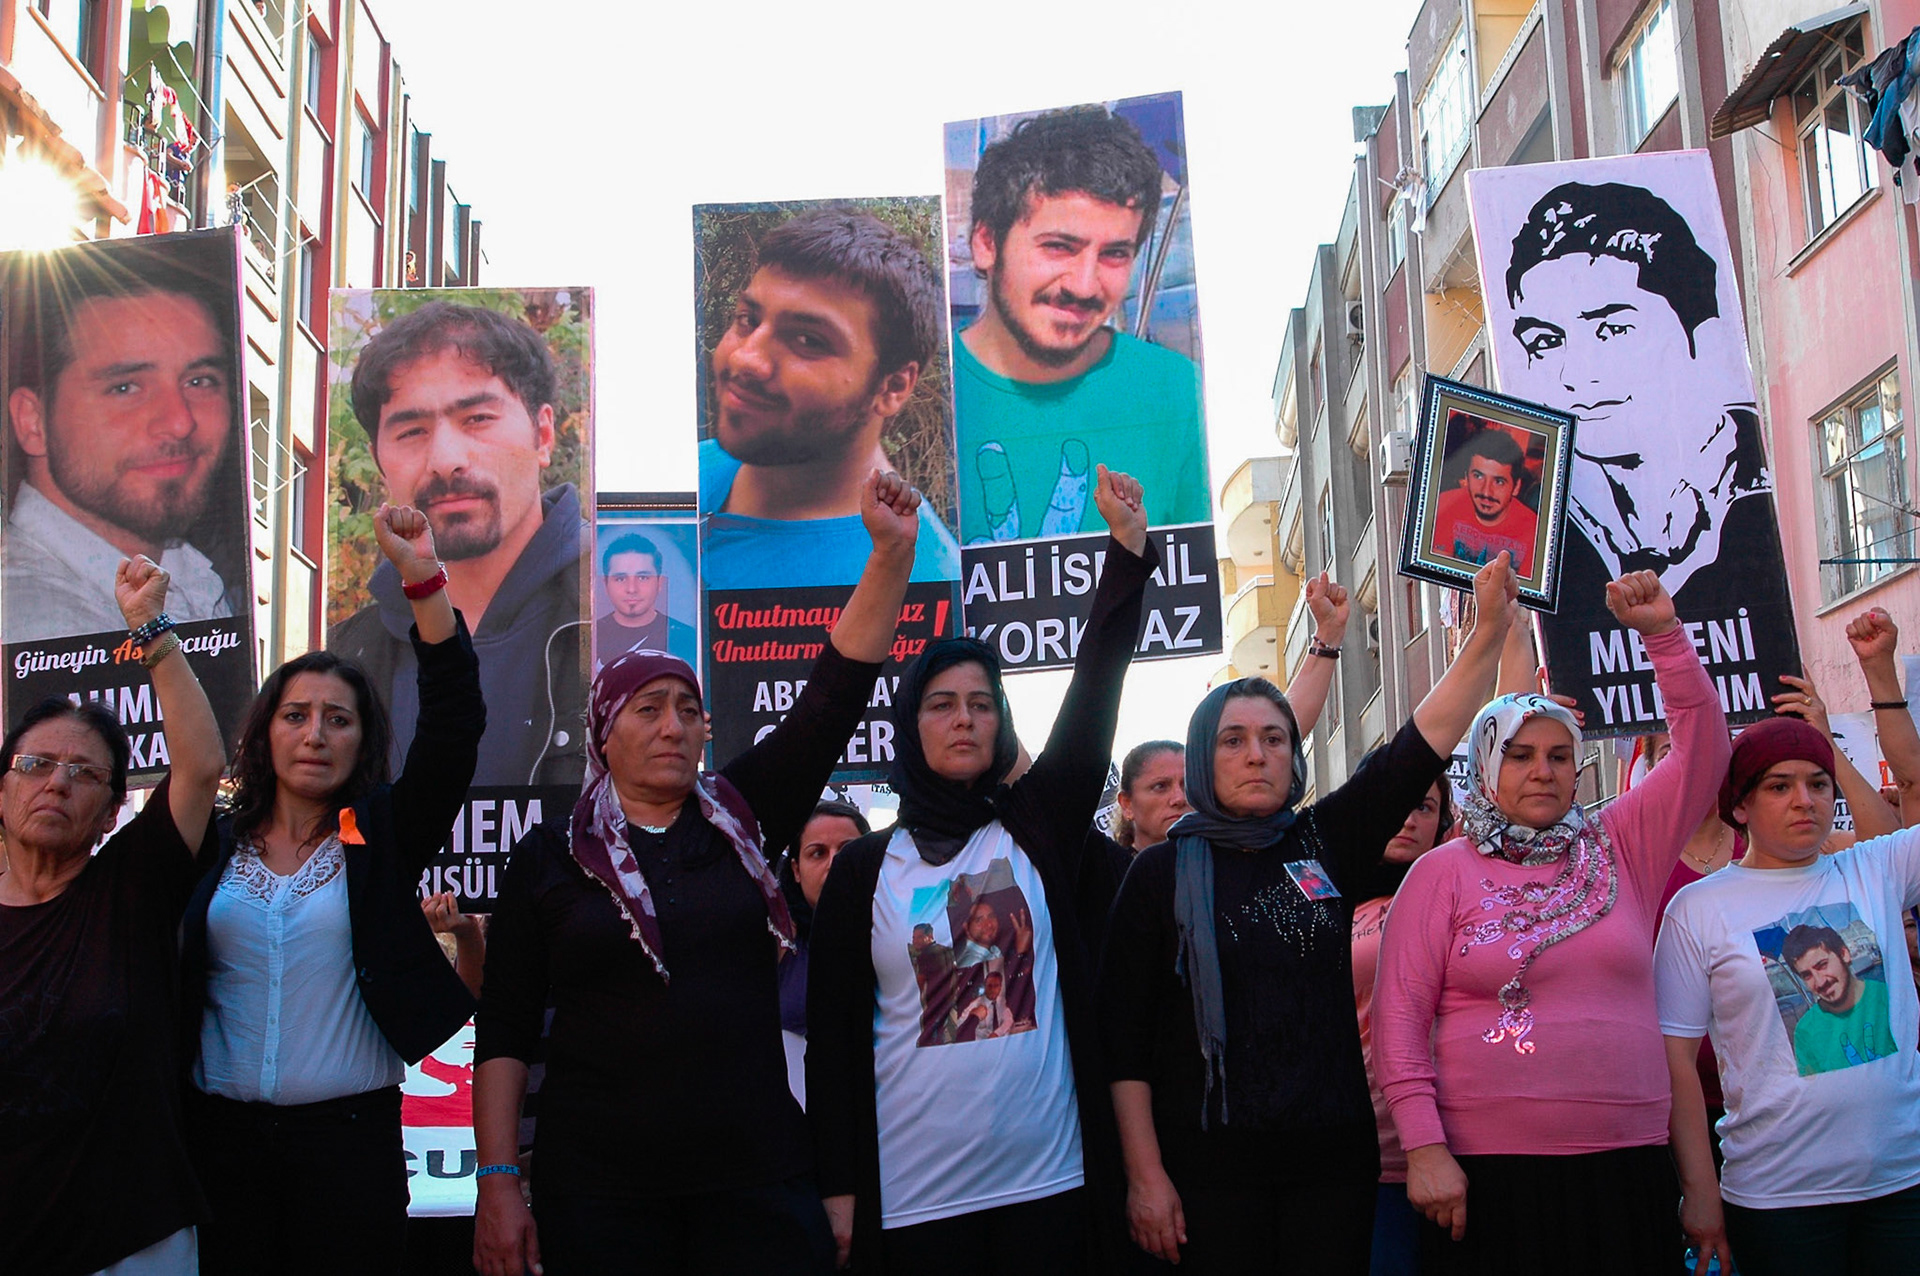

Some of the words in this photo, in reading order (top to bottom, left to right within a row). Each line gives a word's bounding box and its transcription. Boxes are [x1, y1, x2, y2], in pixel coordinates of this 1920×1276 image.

[964, 547, 1036, 604] ALİ
[14, 644, 110, 679] Güneyin
[112, 639, 145, 665] As
[1589, 607, 1756, 676] MEENİ
